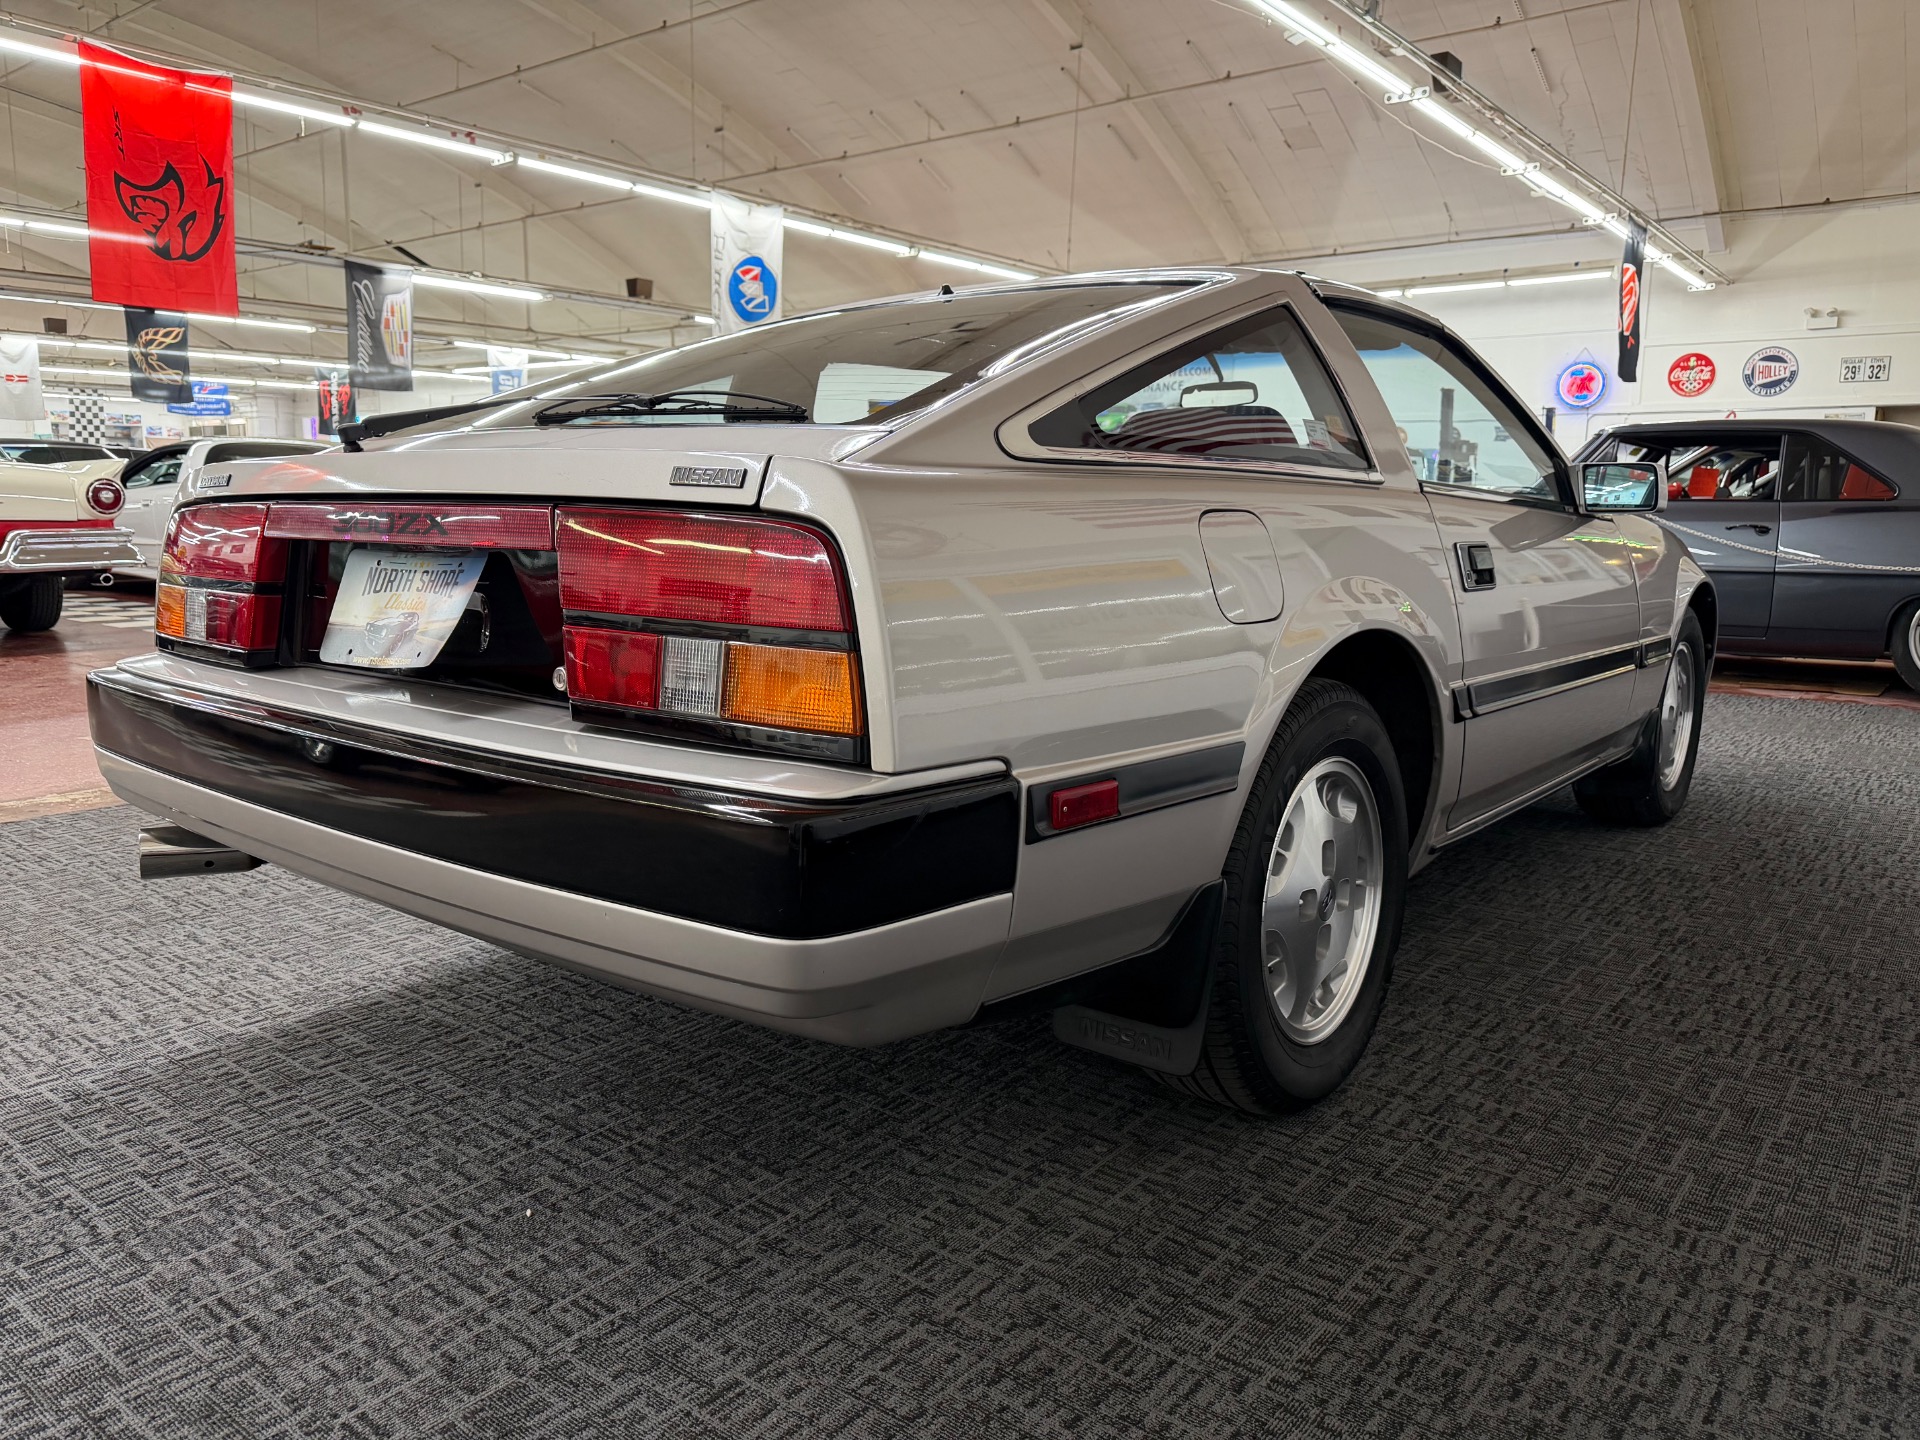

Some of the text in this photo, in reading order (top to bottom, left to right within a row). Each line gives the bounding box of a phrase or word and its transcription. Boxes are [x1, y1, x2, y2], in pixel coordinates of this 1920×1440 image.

[112, 105, 125, 162] SRT
[352, 279, 376, 374] Cadillac
[1670, 365, 1714, 382] Coca-Cola
[1757, 364, 1788, 381] HOLLEY
[671, 466, 743, 486] NISSAN
[361, 566, 465, 599] NORTH SHORE
[383, 592, 429, 612] Classics
[1079, 1016, 1172, 1060] NISSAN
